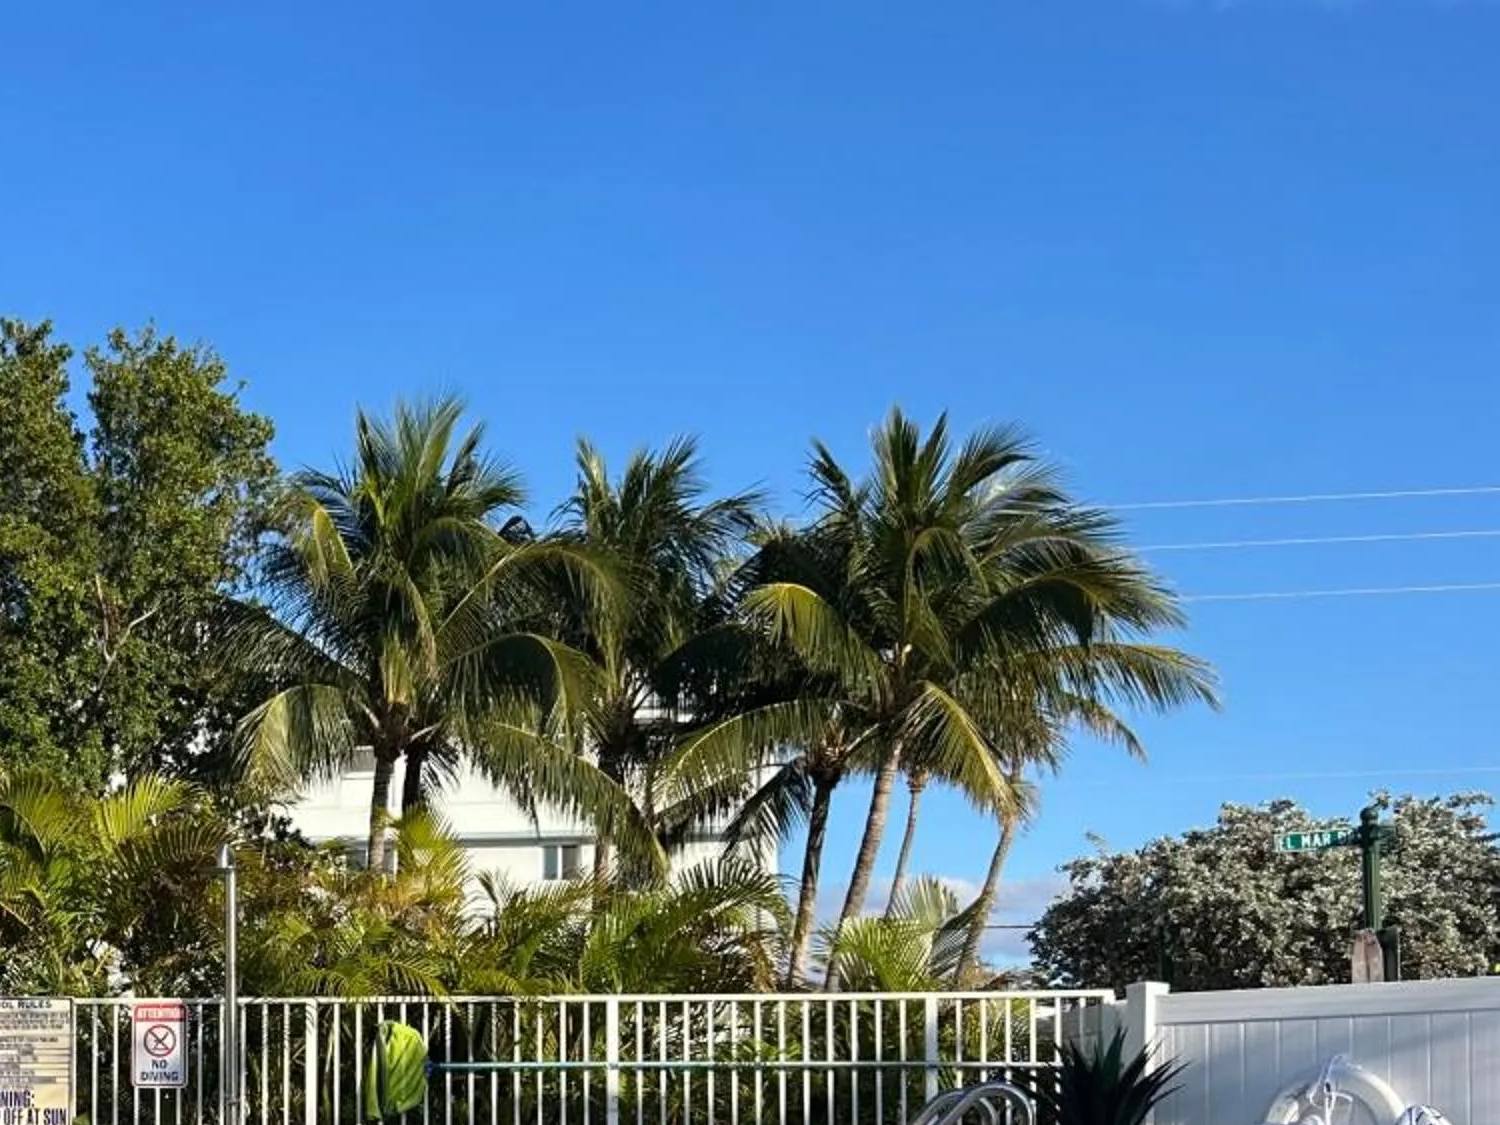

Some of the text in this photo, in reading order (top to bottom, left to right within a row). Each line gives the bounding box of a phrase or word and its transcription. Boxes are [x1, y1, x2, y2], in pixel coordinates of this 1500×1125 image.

[17, 1001, 53, 1009] RULES
[151, 1059, 168, 1069] NO
[140, 1071, 179, 1081] DIVING
[3, 1108, 24, 1125] OFF
[27, 1108, 41, 1125] AT
[43, 1108, 67, 1125] SUN
